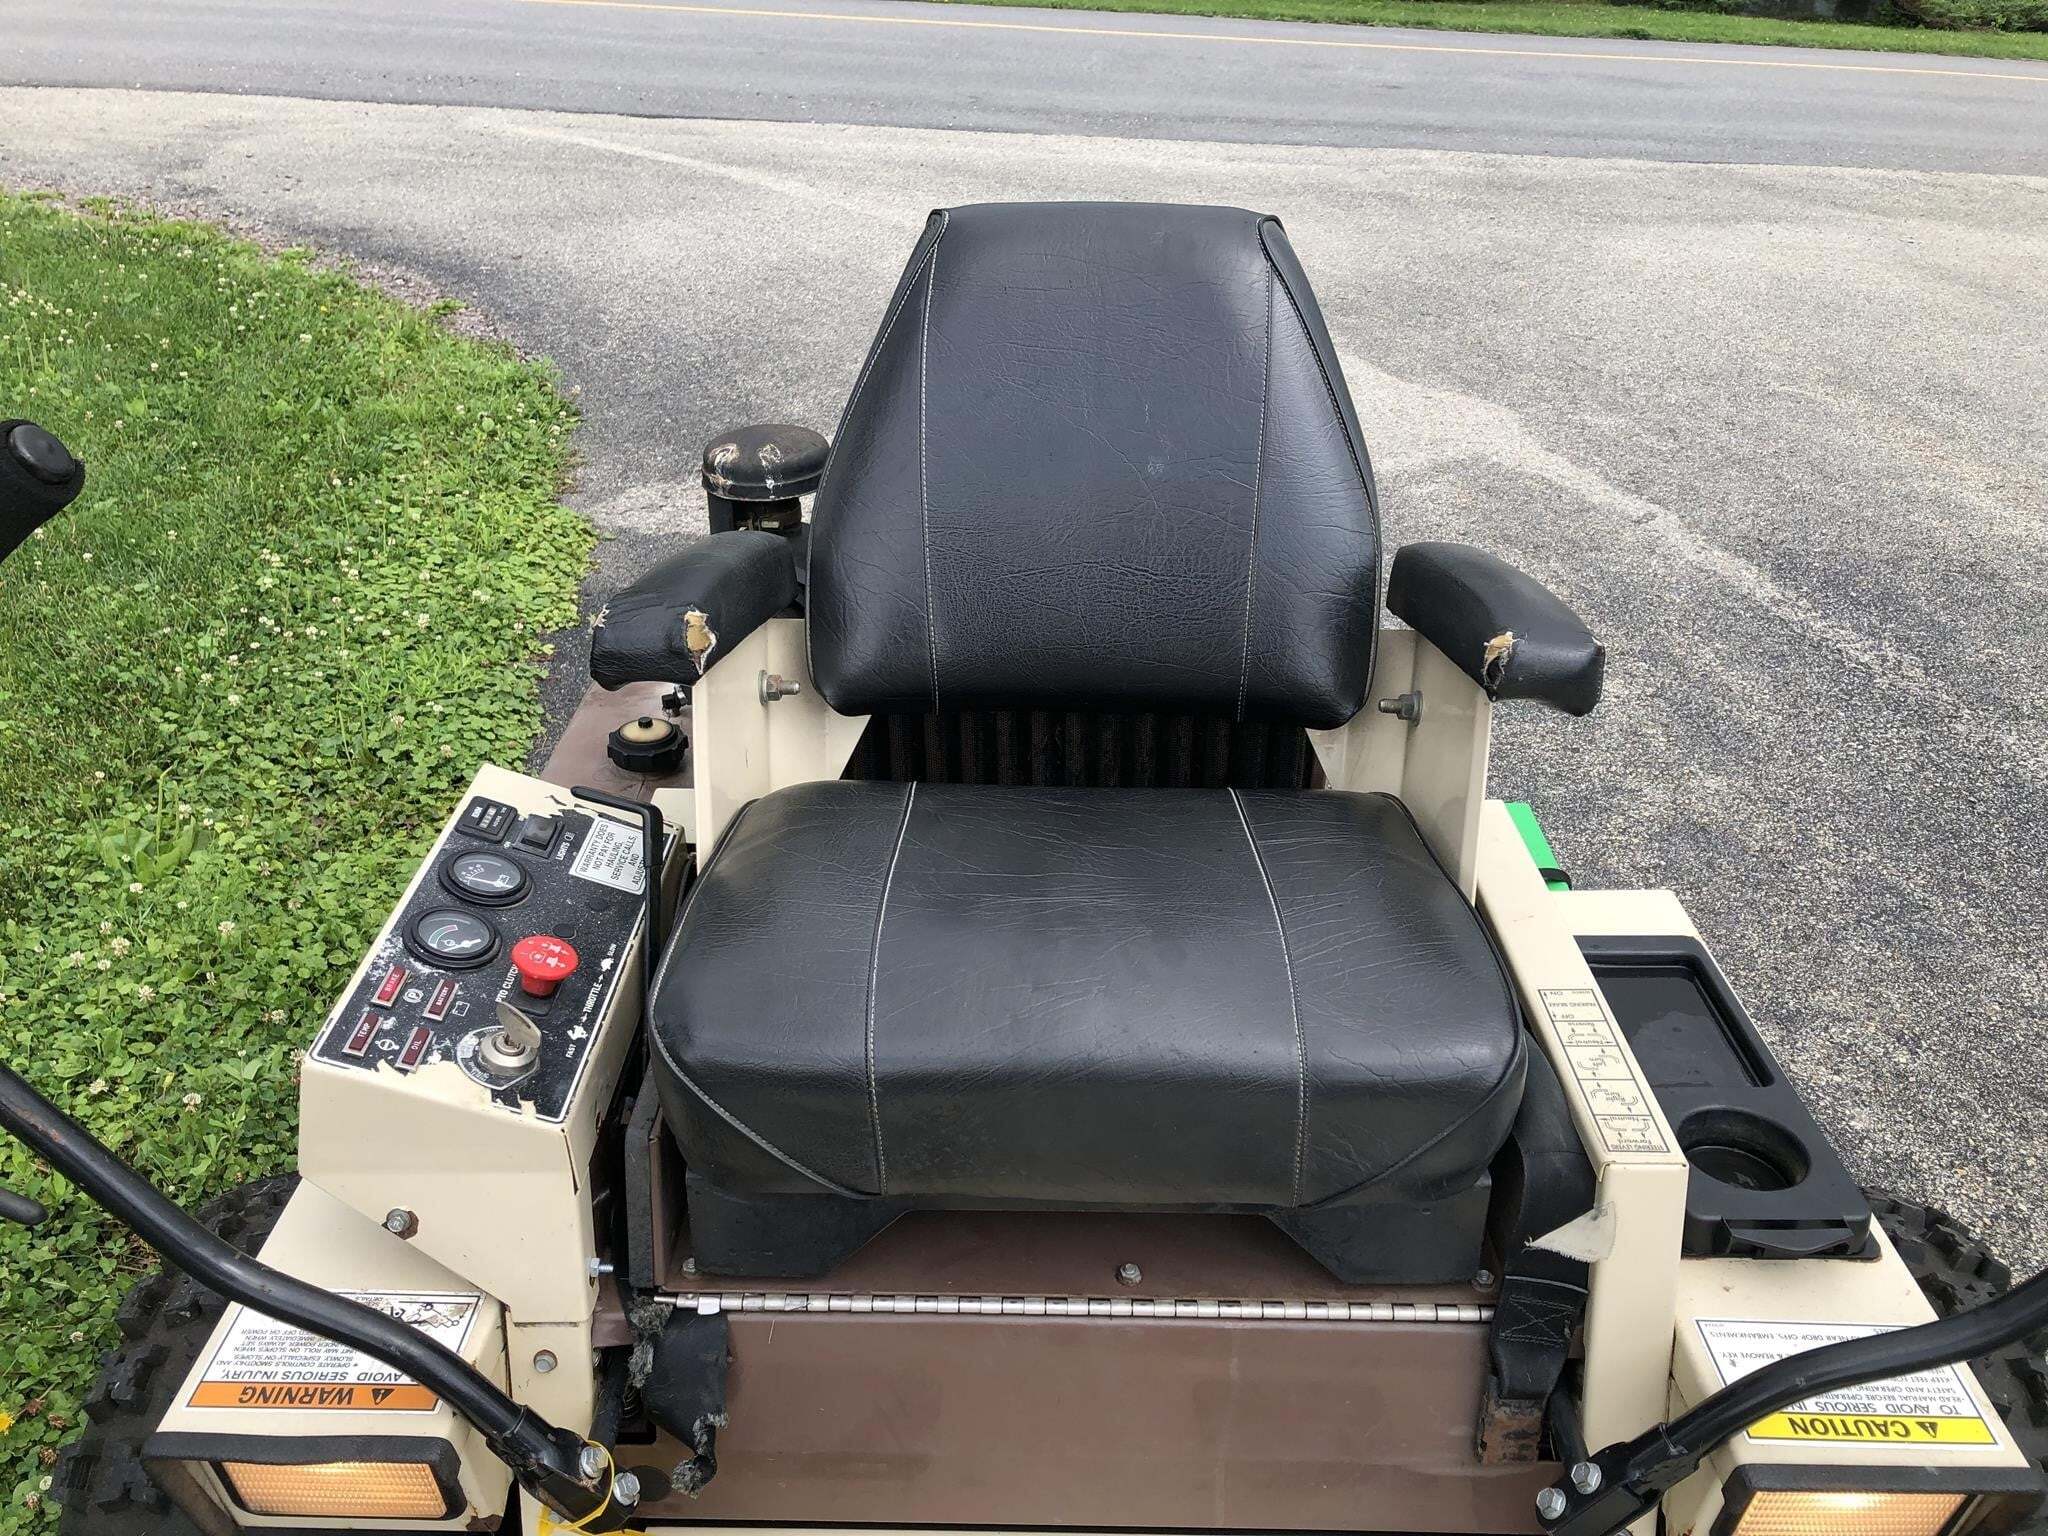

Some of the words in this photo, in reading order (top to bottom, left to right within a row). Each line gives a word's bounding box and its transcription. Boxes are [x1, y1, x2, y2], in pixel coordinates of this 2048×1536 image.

[555, 842, 570, 861] LIGHTS
[580, 841, 600, 872] WARRANTY
[597, 824, 609, 840] DOES
[592, 857, 603, 870] NOT
[600, 844, 609, 858] PAY
[606, 832, 616, 845] FOR
[611, 856, 628, 880] SERVICE
[628, 853, 640, 867] AND
[386, 973, 400, 992] BRAKE
[436, 986, 449, 1006] BATTERY
[495, 985, 508, 1002] PTO
[583, 981, 603, 1013] THROTTLE
[358, 1022, 371, 1038] TEMP
[412, 1040, 421, 1050] OIL
[566, 1044, 577, 1059] FAST
[1710, 1331, 1774, 1340] EMBANKMENTS
[221, 1369, 278, 1380] INJURY,
[281, 1371, 349, 1381] SERIOUS
[357, 1372, 404, 1382] AVOID
[238, 1386, 354, 1406] WARNING
[1815, 1402, 1877, 1413] SERIOUS
[1885, 1403, 1930, 1414] AVOID
[1940, 1405, 1962, 1415] TO
[1788, 1417, 1911, 1438] CAUTION
